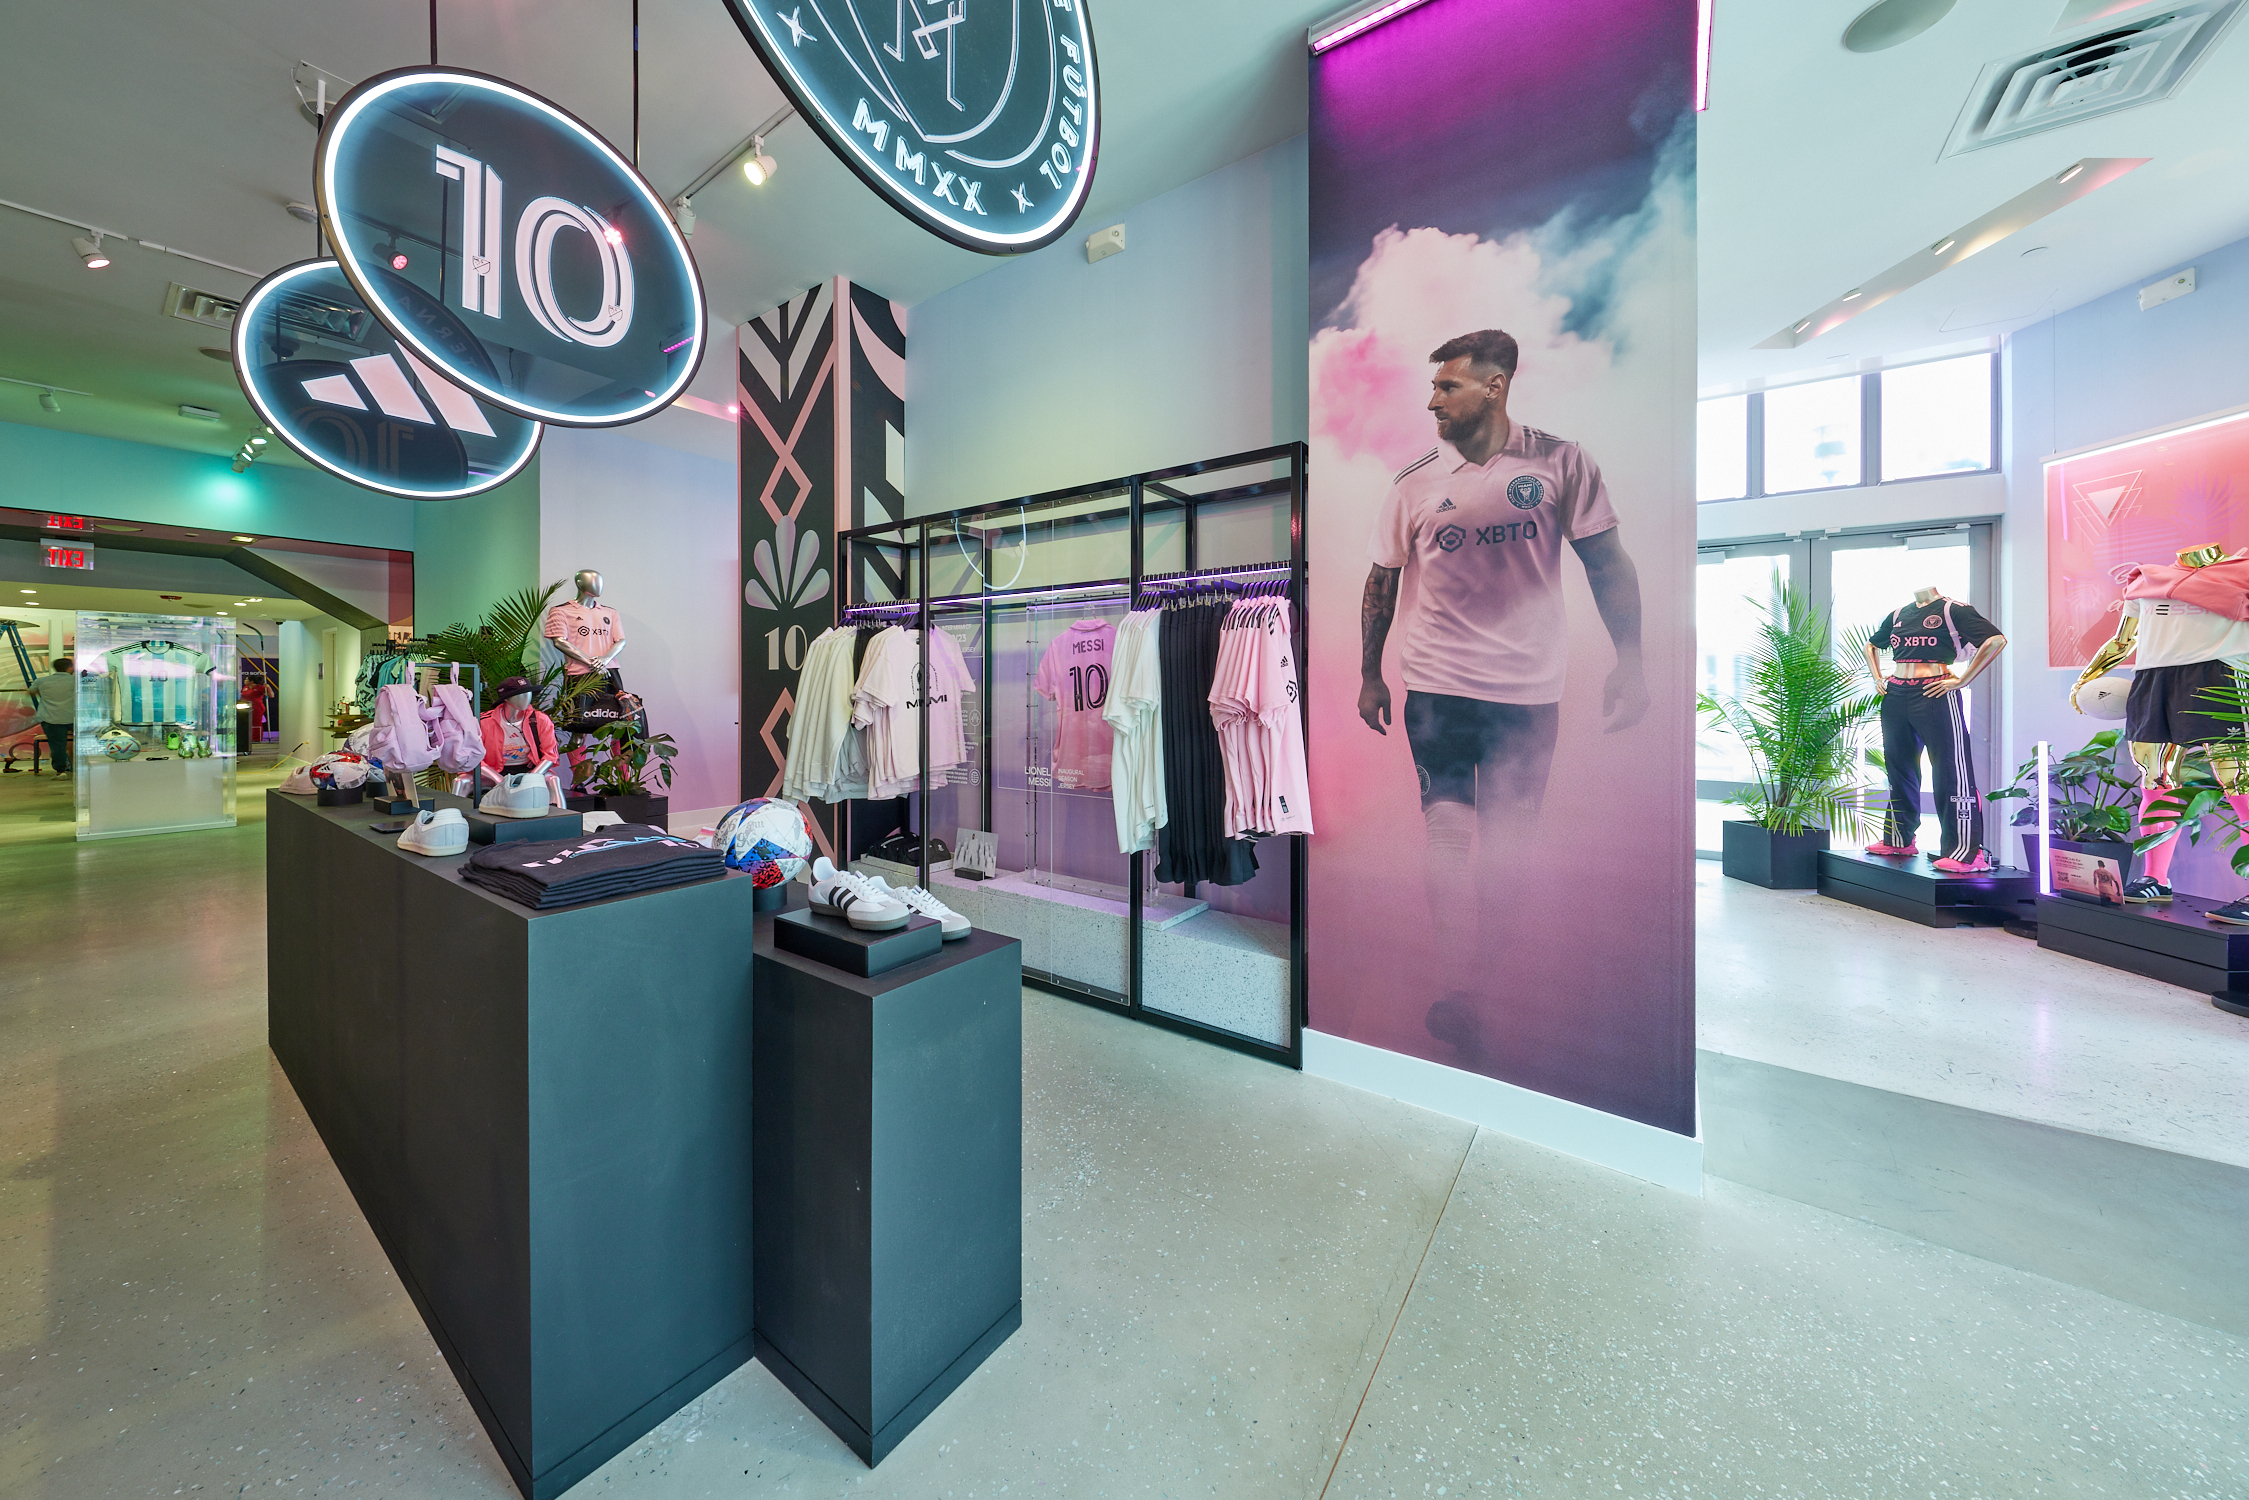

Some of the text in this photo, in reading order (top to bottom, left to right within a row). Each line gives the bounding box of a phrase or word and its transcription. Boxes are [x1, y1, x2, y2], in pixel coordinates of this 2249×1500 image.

[1039, 34, 1088, 190] FÚTBOL
[852, 97, 988, 216] MMXX
[436, 143, 635, 348] 10
[1435, 505, 1457, 514] adidas
[1476, 521, 1538, 546] XBTO
[764, 624, 808, 671] 10
[1072, 639, 1104, 655] MESSI
[1904, 636, 1938, 647] XBTO
[1069, 662, 1109, 712] 10
[1024, 765, 1051, 777] LIONEL
[1057, 768, 1085, 776] INAUGURAL
[1028, 776, 1052, 788] MESSI
[1057, 775, 1078, 783] SEASON
[1057, 782, 1076, 790] JERSEY
